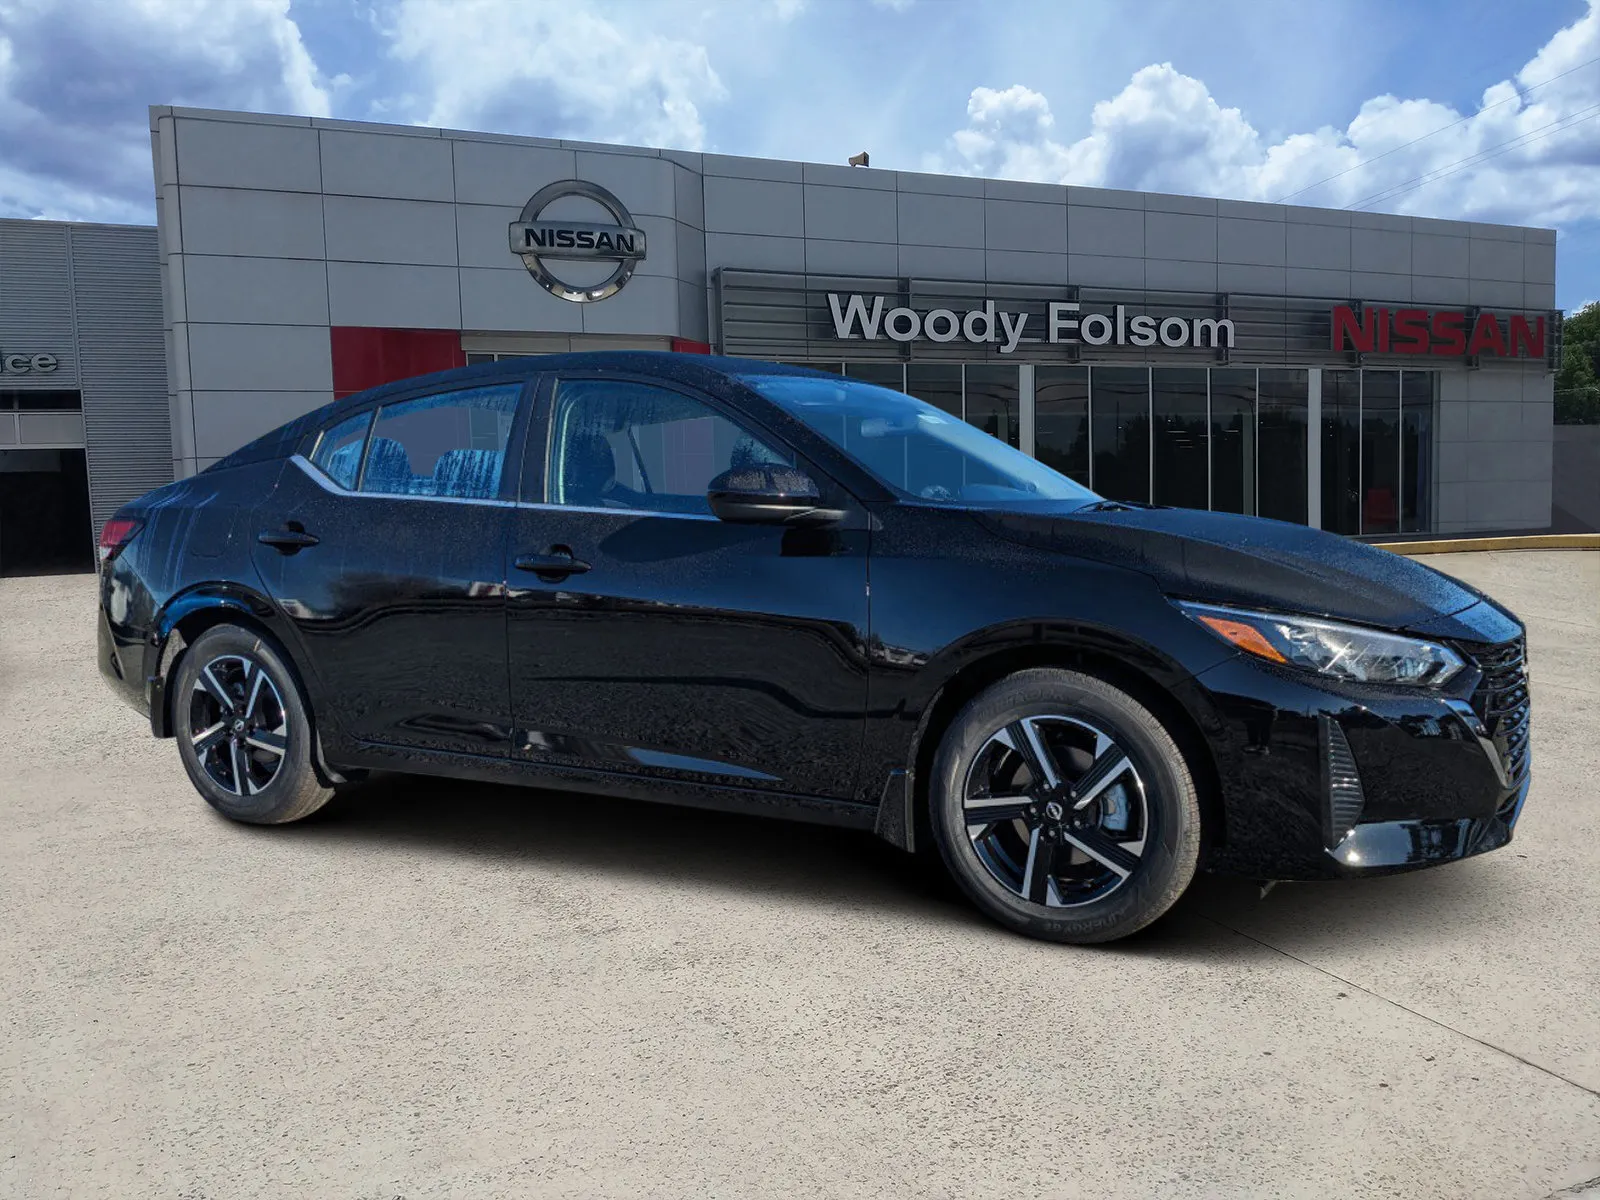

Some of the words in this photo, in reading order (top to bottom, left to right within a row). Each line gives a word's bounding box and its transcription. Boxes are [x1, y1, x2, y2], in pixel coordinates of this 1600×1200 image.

[524, 228, 635, 253] NISSAN
[827, 293, 1029, 354] Woody
[1048, 301, 1236, 348] Folsom
[1332, 305, 1546, 358] NISSAN
[0, 352, 57, 374] ce
